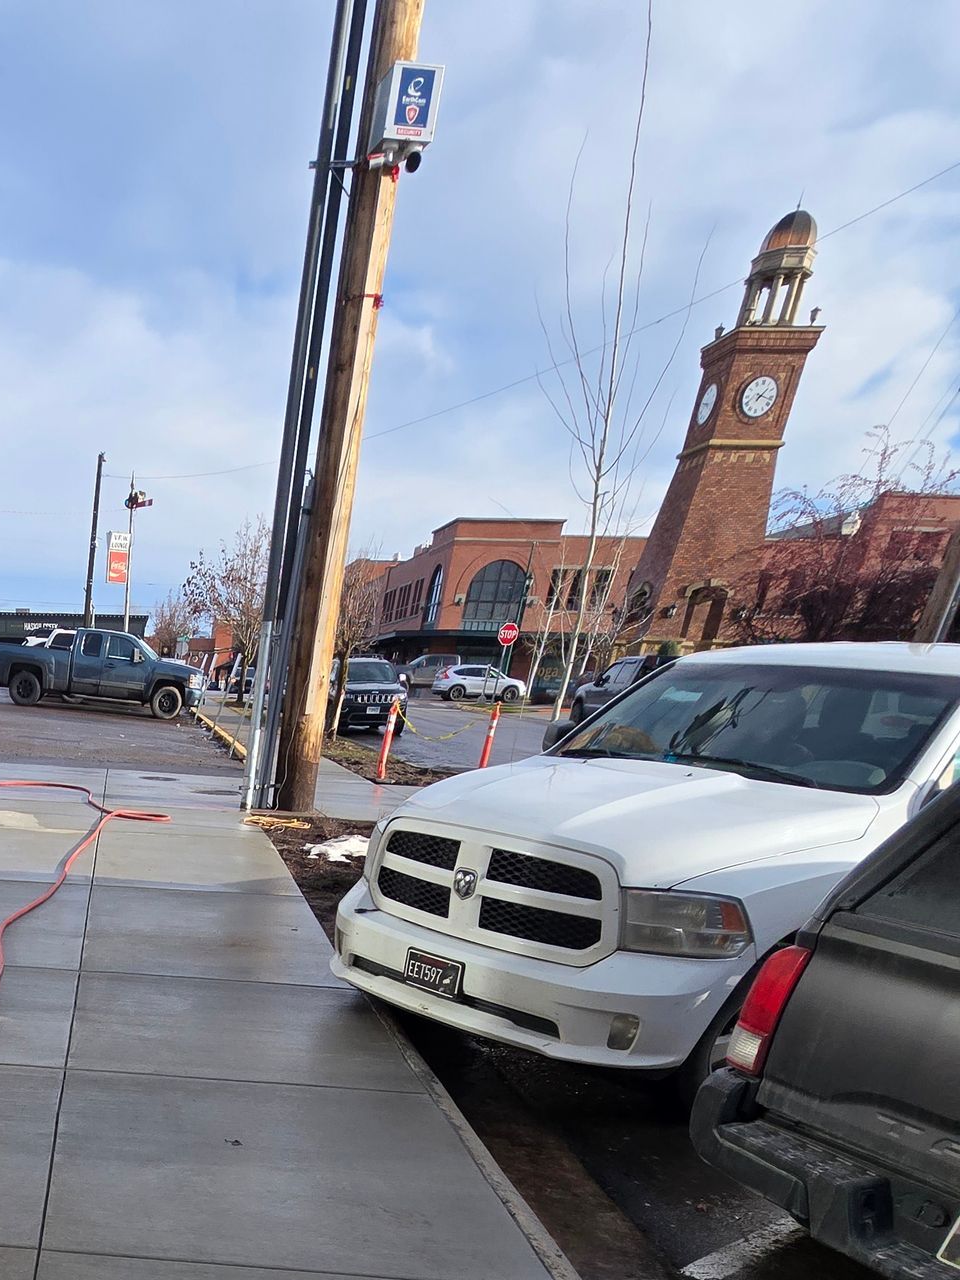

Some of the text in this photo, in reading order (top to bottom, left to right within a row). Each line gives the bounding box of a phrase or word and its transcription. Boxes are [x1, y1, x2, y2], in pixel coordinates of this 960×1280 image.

[500, 630, 517, 639] STOP
[538, 667, 559, 680] oga
[408, 960, 443, 985] EET597
